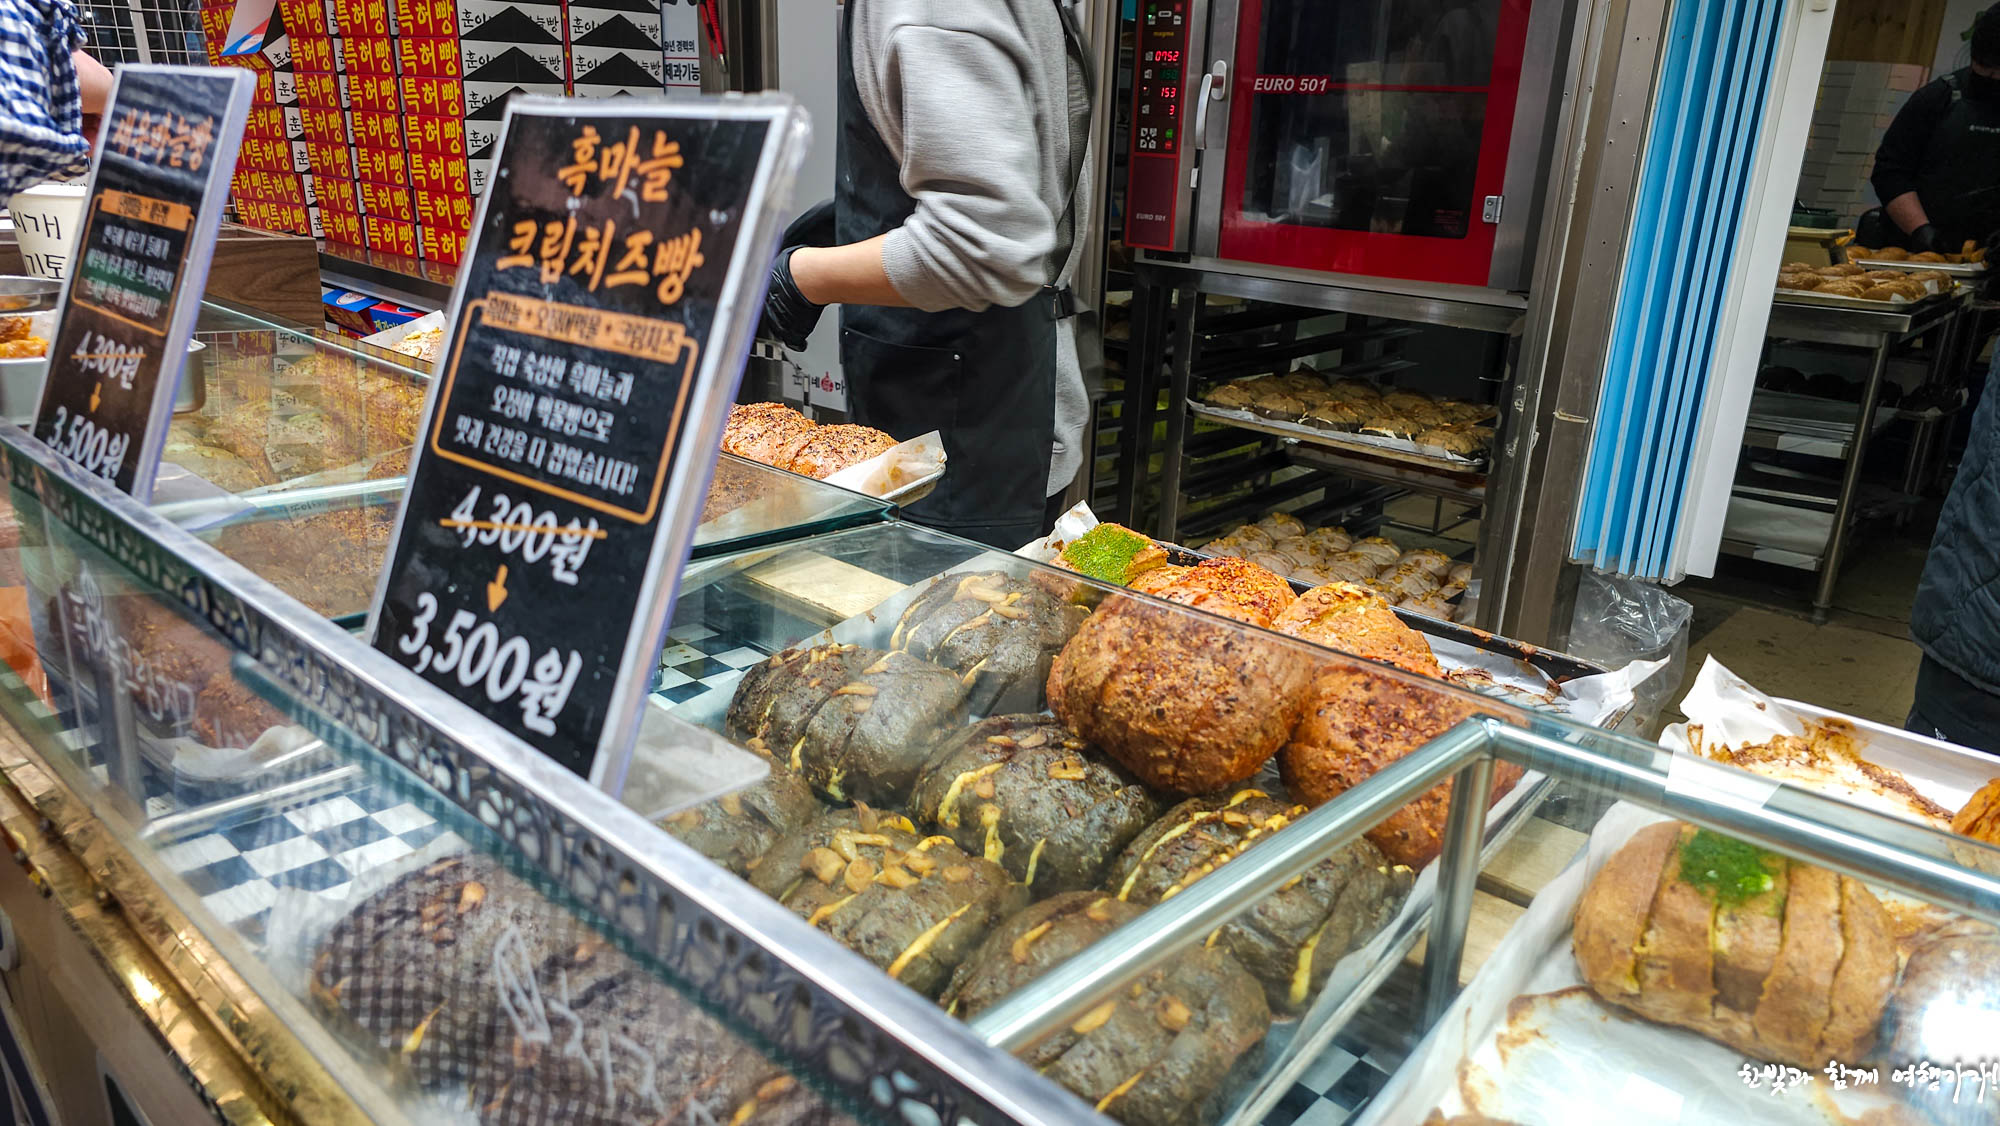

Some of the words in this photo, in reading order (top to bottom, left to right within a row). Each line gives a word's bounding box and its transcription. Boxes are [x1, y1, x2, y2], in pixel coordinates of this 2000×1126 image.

[280, 0, 322, 34] 특허빵
[336, 0, 384, 33] 특허빵
[398, 0, 453, 34] 특허빵
[290, 37, 330, 70] 특허빵
[344, 37, 391, 72] 특허빵
[401, 38, 458, 75] 특허빵
[1155, 50, 1180, 62] 0752
[295, 73, 336, 106] 특허빵
[349, 75, 396, 110] 특허빵
[404, 77, 461, 115] 특허빵
[1161, 87, 1177, 98] 153
[1254, 78, 1295, 91] EURO
[1299, 78, 1328, 92] 501
[301, 108, 342, 142] 특허빵
[1168, 104, 1176, 116] 3
[352, 111, 399, 147] 특허빵
[406, 115, 462, 153] 특허빵
[250, 138, 289, 170] 특허빵
[307, 142, 349, 177] 특허빵
[358, 148, 404, 184] 특허빵
[558, 125, 684, 201] 흑마늘
[261, 171, 300, 204] 특허빵
[411, 153, 467, 192] 특허빵
[314, 175, 354, 212] 특허빵
[362, 183, 410, 220] 특허빵
[418, 190, 472, 230] 특허빵
[269, 203, 307, 234] 특허빵
[321, 208, 361, 245] 특허빵
[367, 217, 414, 255] 특허빵
[496, 216, 704, 305] 크림치즈빵
[450, 485, 599, 586] 4,300원
[399, 592, 583, 736] 3,500원
